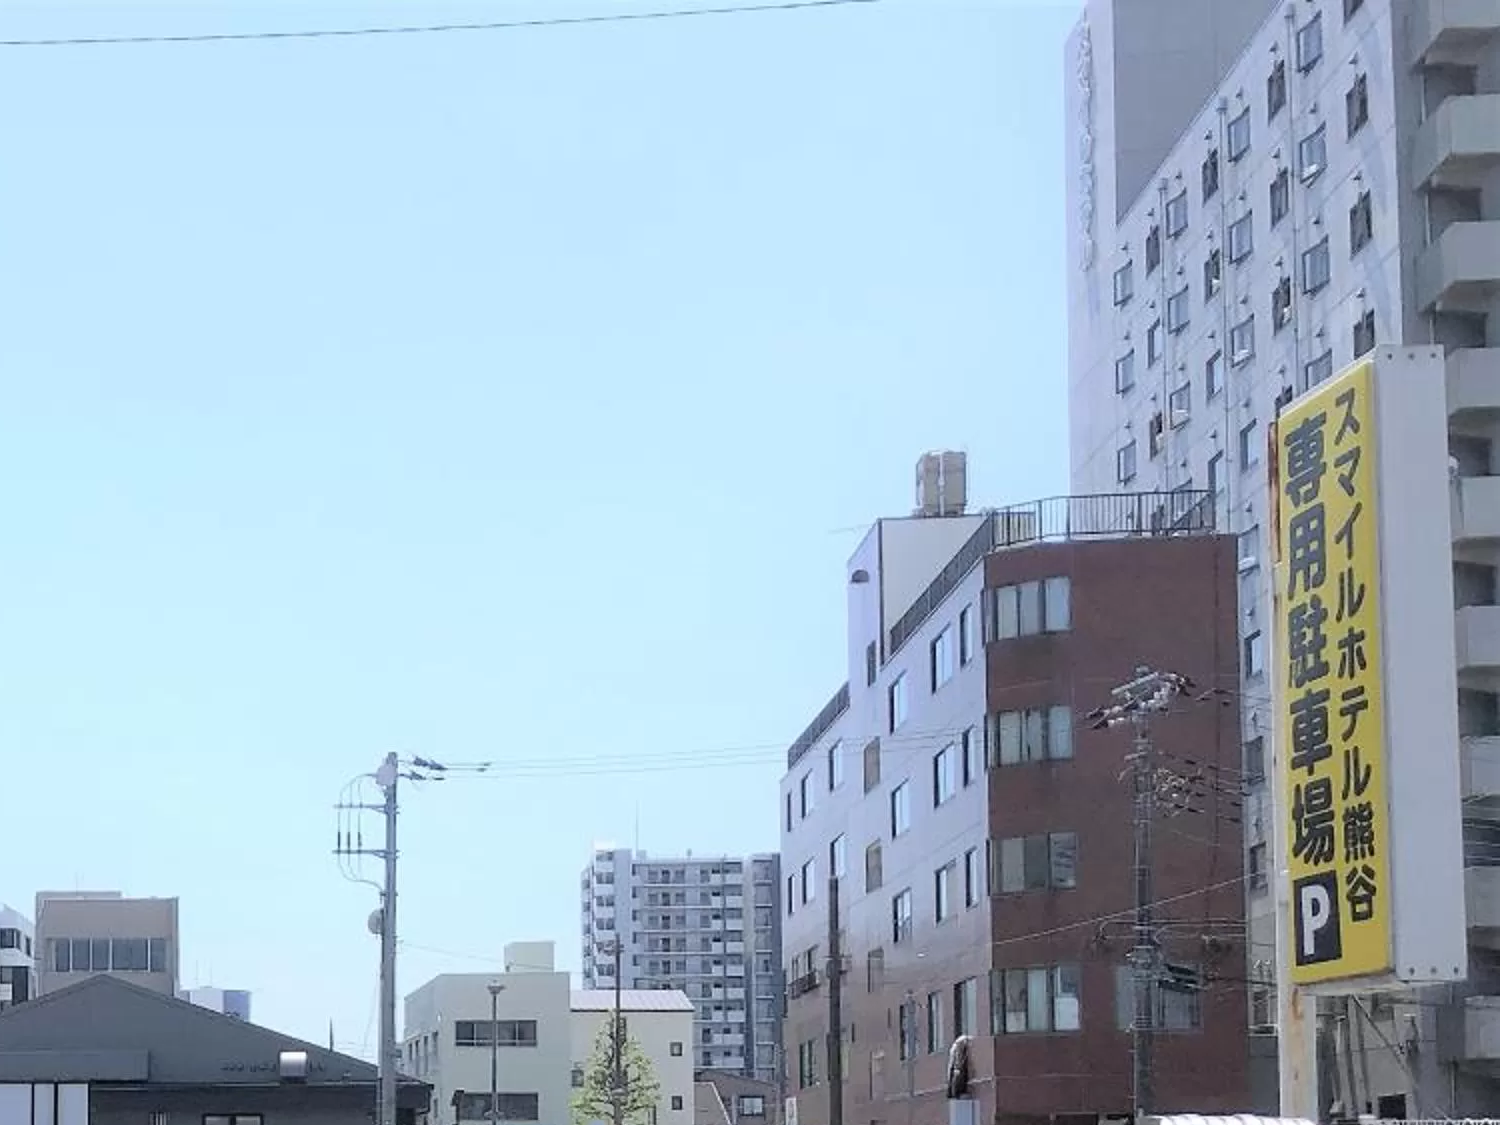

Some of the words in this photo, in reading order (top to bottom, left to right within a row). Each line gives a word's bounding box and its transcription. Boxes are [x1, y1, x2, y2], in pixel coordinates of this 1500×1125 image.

[1283, 410, 1336, 866] 専用駐車場
[1333, 386, 1377, 923] スマイルホテル熊谷
[1300, 885, 1330, 956] P
